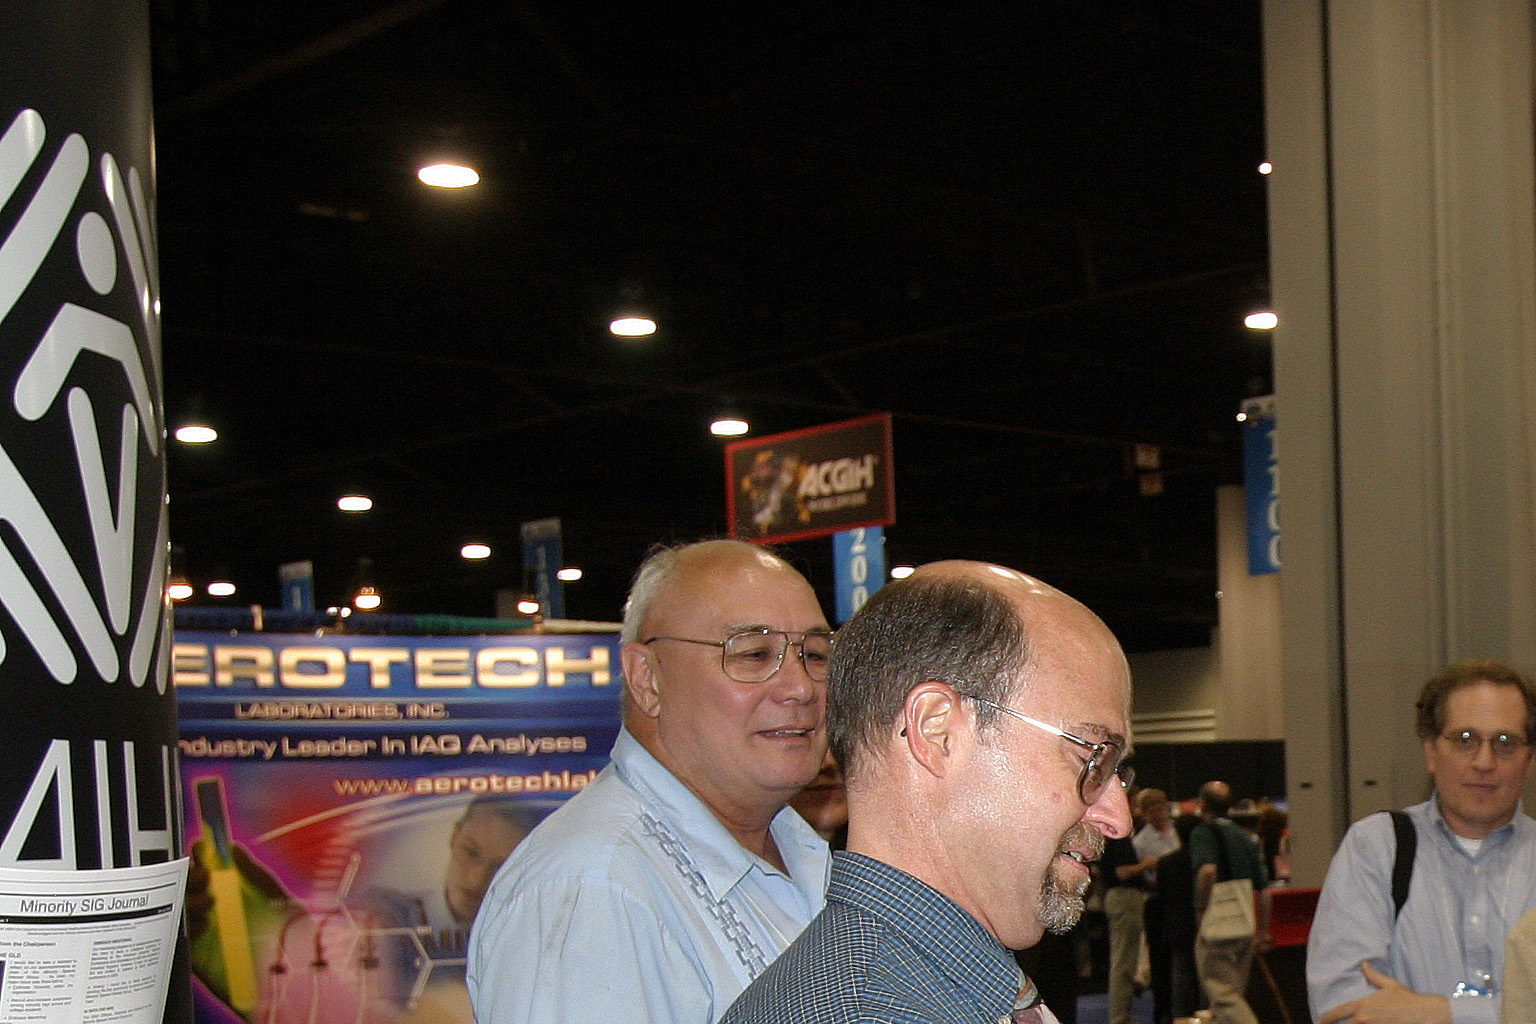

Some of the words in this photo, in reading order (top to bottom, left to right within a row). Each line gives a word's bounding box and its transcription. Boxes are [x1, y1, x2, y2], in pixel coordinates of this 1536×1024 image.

[173, 645, 611, 690] EROTECH
[234, 703, 402, 720] LABORATORIES,
[406, 702, 450, 718] INC.
[178, 737, 277, 760] ndustry
[281, 736, 377, 757] Leader
[382, 736, 406, 756] In
[410, 734, 461, 756] IAQ
[467, 734, 588, 757] Analyses
[20, 899, 77, 916] Minority
[80, 897, 105, 912] SIG
[107, 894, 149, 911] Journal
